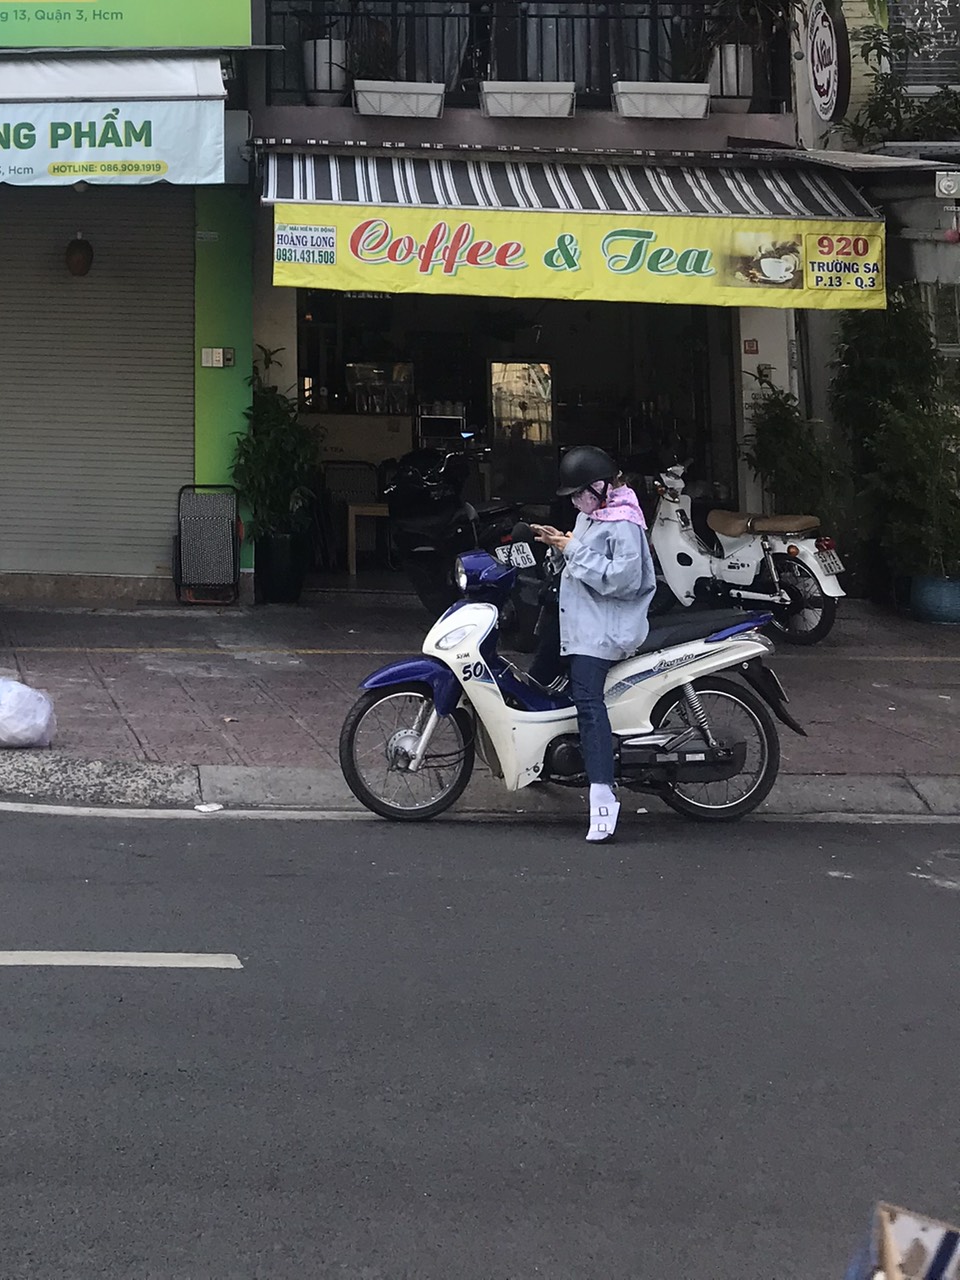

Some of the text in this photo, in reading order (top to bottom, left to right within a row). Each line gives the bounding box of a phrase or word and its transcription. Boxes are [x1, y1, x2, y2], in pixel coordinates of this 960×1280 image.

[13, 9, 30, 23] 13,
[34, 7, 73, 24] Quận
[76, 8, 88, 22] 3,
[92, 8, 123, 22] Hcm
[49, 108, 153, 149] PHẨM
[8, 165, 34, 176] Hcm
[52, 162, 162, 175] HOTLINE: 086.909.1919
[277, 232, 335, 248] HOÀNG LONG
[349, 219, 717, 277] Coffee & Tea
[817, 236, 869, 256] 920
[276, 248, 335, 264] 0931.431.508
[809, 259, 880, 273] TRƯỜNG SA
[815, 276, 876, 289] P.13 Q.3
[462, 661, 483, 682] 50
